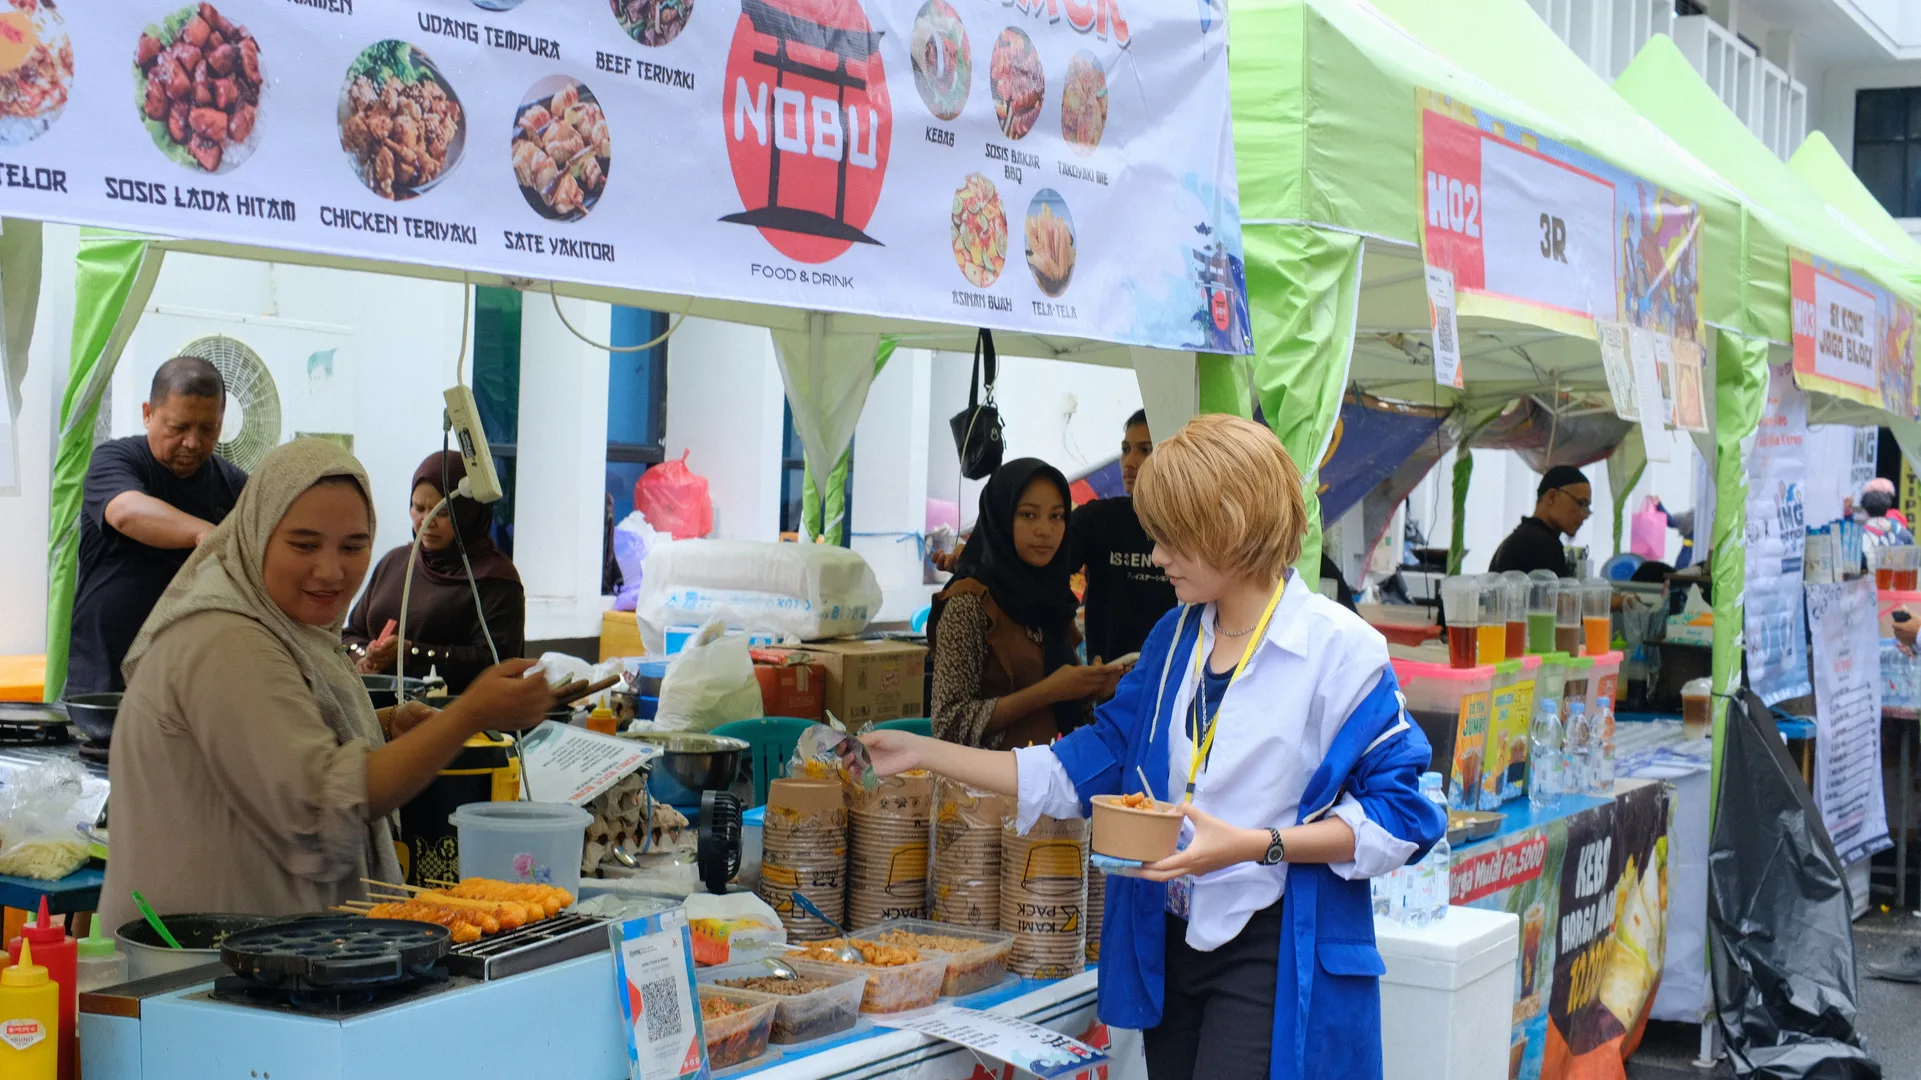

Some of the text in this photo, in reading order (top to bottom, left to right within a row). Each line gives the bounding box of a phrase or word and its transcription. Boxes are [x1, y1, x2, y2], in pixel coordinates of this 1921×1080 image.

[417, 12, 561, 61] UDANG TEMPURA
[596, 51, 695, 91] BEEF TERIYAKI
[734, 76, 878, 169] NOBU
[925, 125, 955, 147] KEBAB
[985, 143, 1040, 171] SOSIS BAKAR
[1004, 166, 1022, 185] BBQ
[1058, 160, 1095, 183] TAKOYAKI
[105, 176, 296, 222] SOSIS LADA HITAM
[320, 206, 477, 245] CHICKEN TERIYAKI
[1540, 213, 1568, 264] 3R
[504, 231, 615, 263] SATE YAKITORI
[751, 263, 854, 289] FOOD & DRINK
[952, 290, 1012, 312] ASINAN BUAH
[1503, 840, 1545, 880] Rp.5000
[882, 907, 921, 920] PACK
[1017, 902, 1055, 917] PACK
[1018, 920, 1055, 933] KAMI
